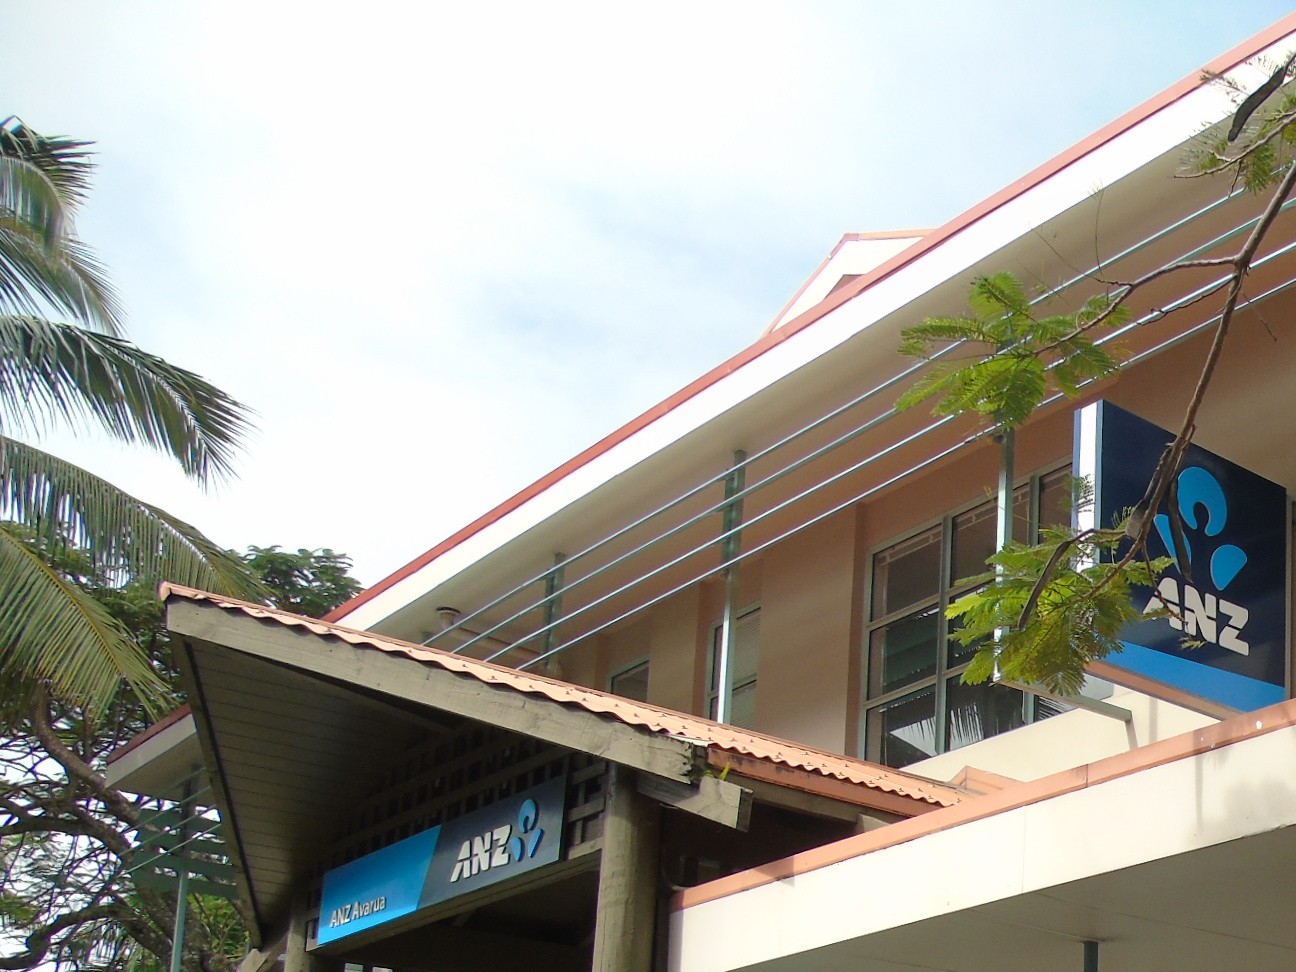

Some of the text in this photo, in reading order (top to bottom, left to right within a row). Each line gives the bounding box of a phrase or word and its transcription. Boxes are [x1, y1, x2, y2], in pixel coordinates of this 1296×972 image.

[1142, 577, 1249, 656] ANZ
[450, 824, 512, 883] ANZ
[330, 896, 387, 928] ANZ Avarua
